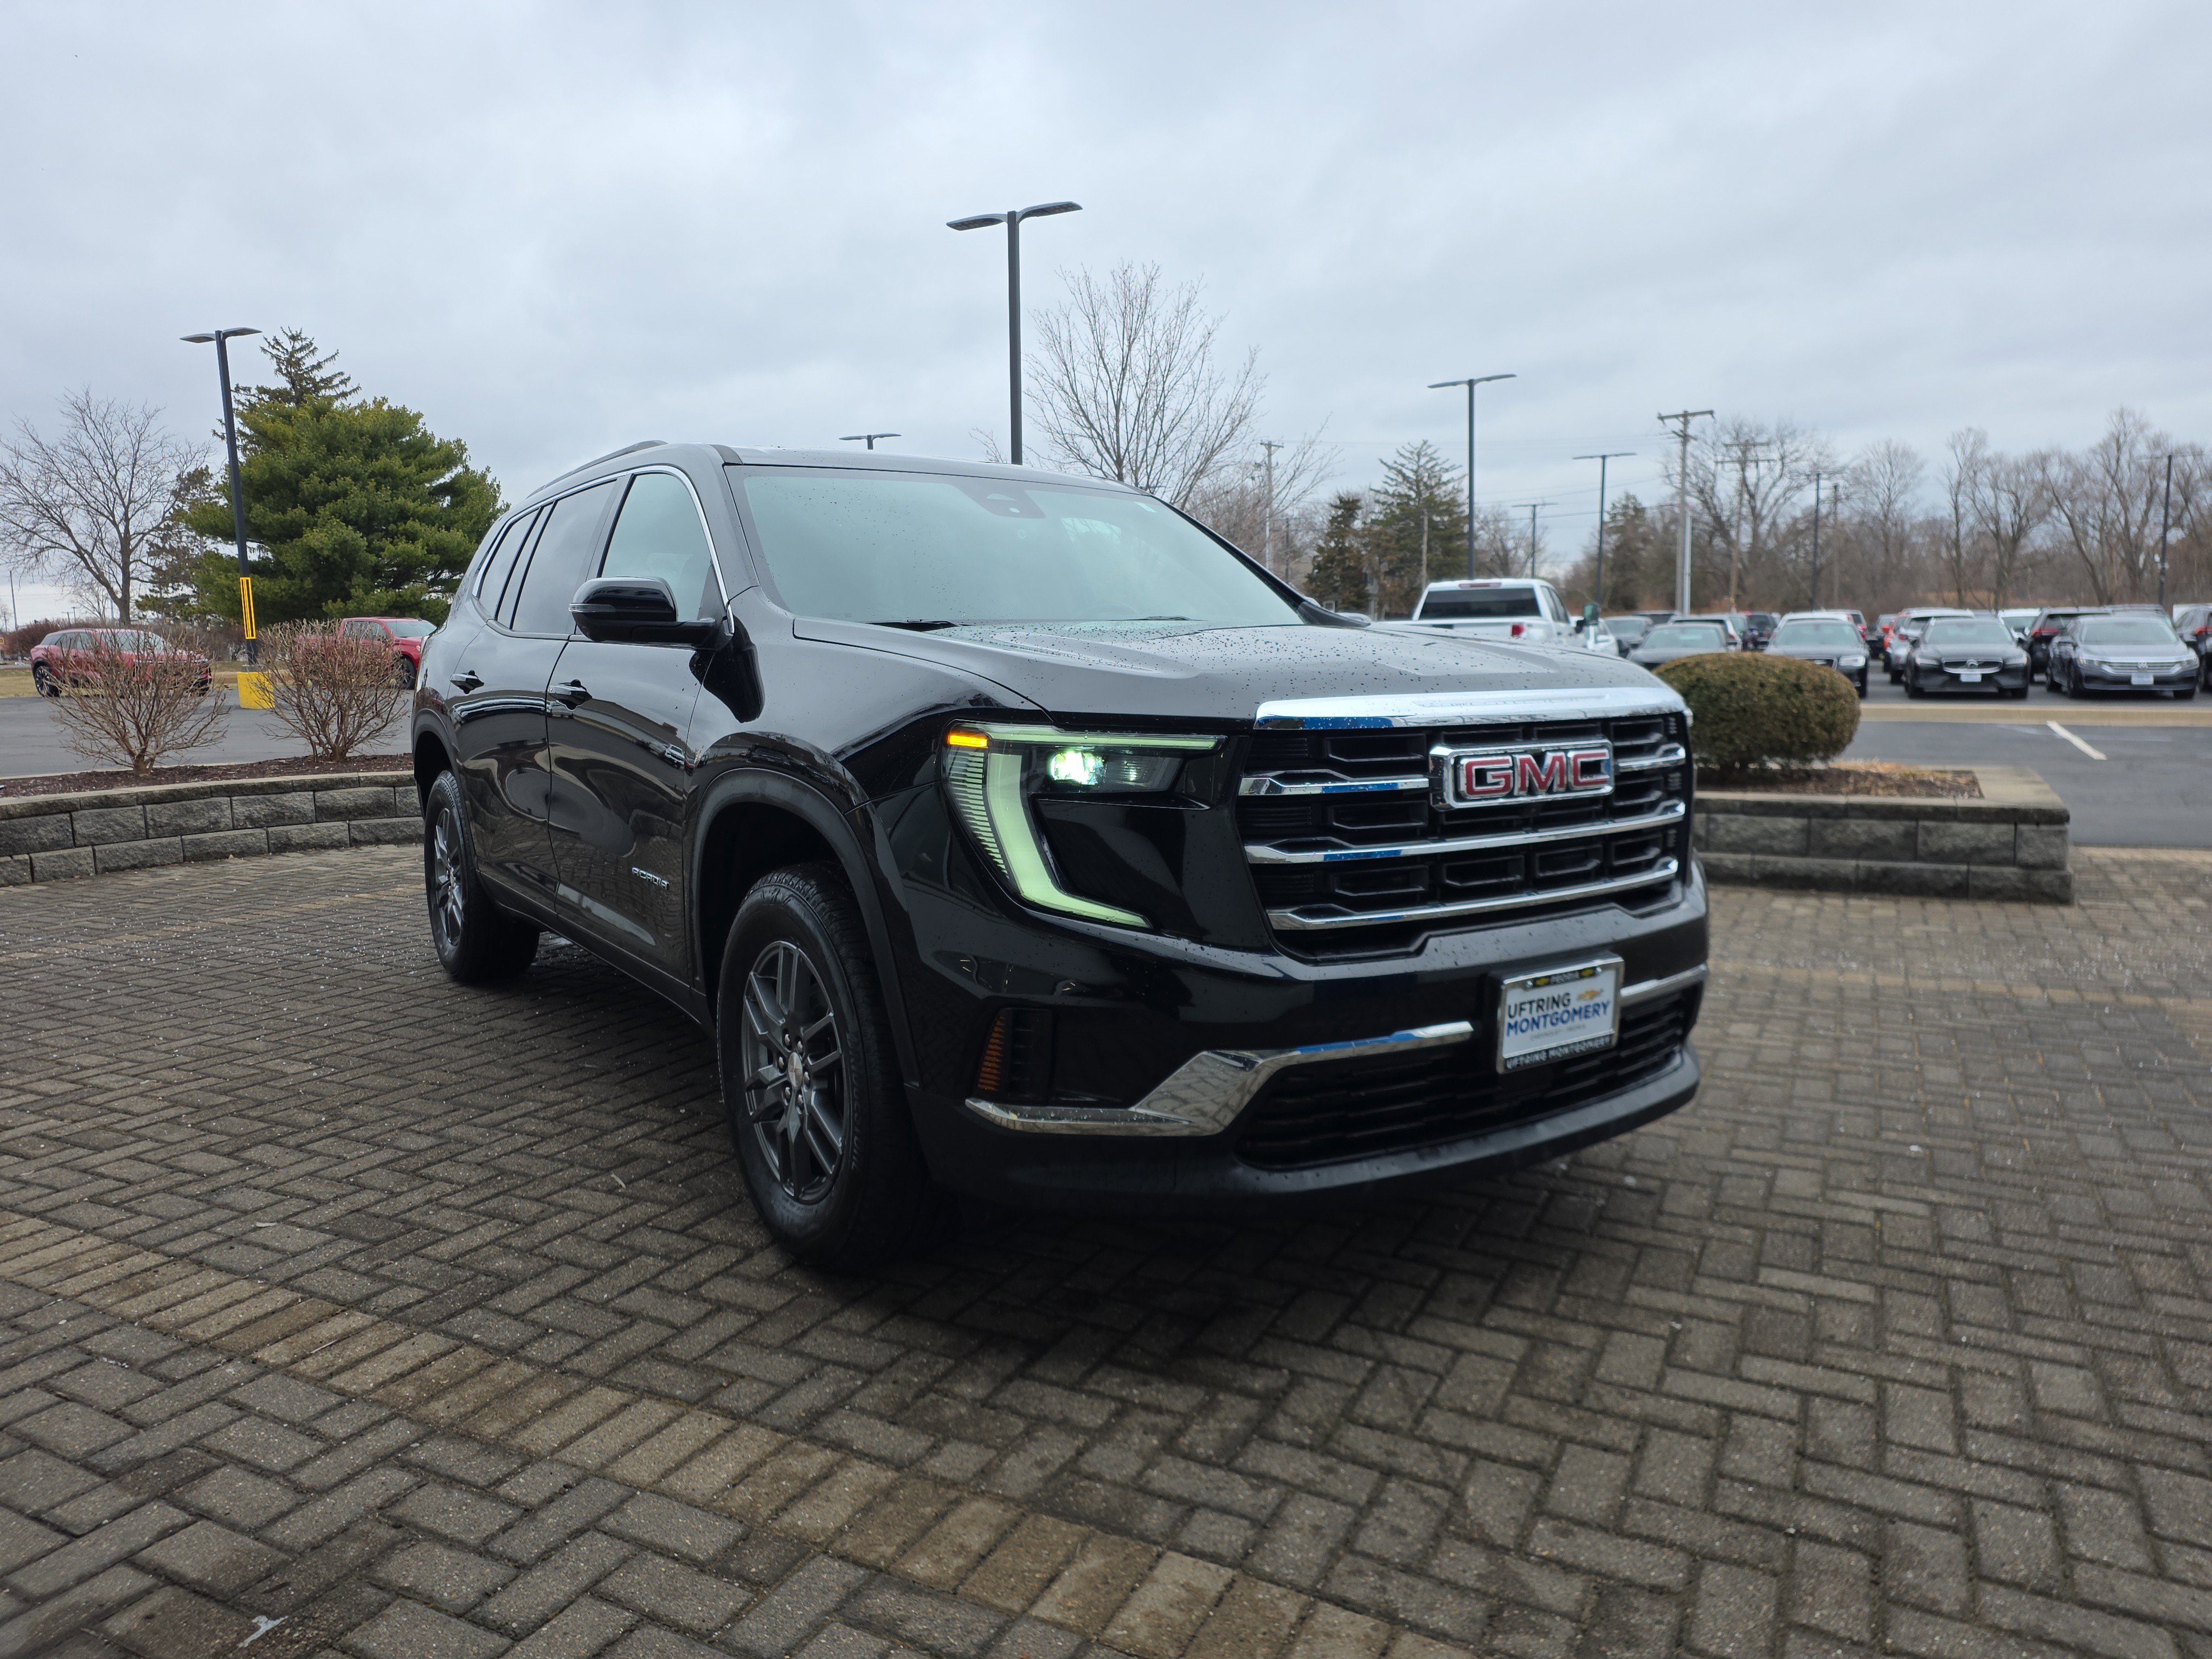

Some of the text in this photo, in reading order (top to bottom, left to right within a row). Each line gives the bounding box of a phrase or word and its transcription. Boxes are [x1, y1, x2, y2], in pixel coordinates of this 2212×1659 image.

[1459, 748, 1610, 799] GMC
[632, 867, 670, 890] ACADIA
[1506, 999, 1611, 1037] MONTGOMERY
[1508, 992, 1571, 1019] UFTRING
